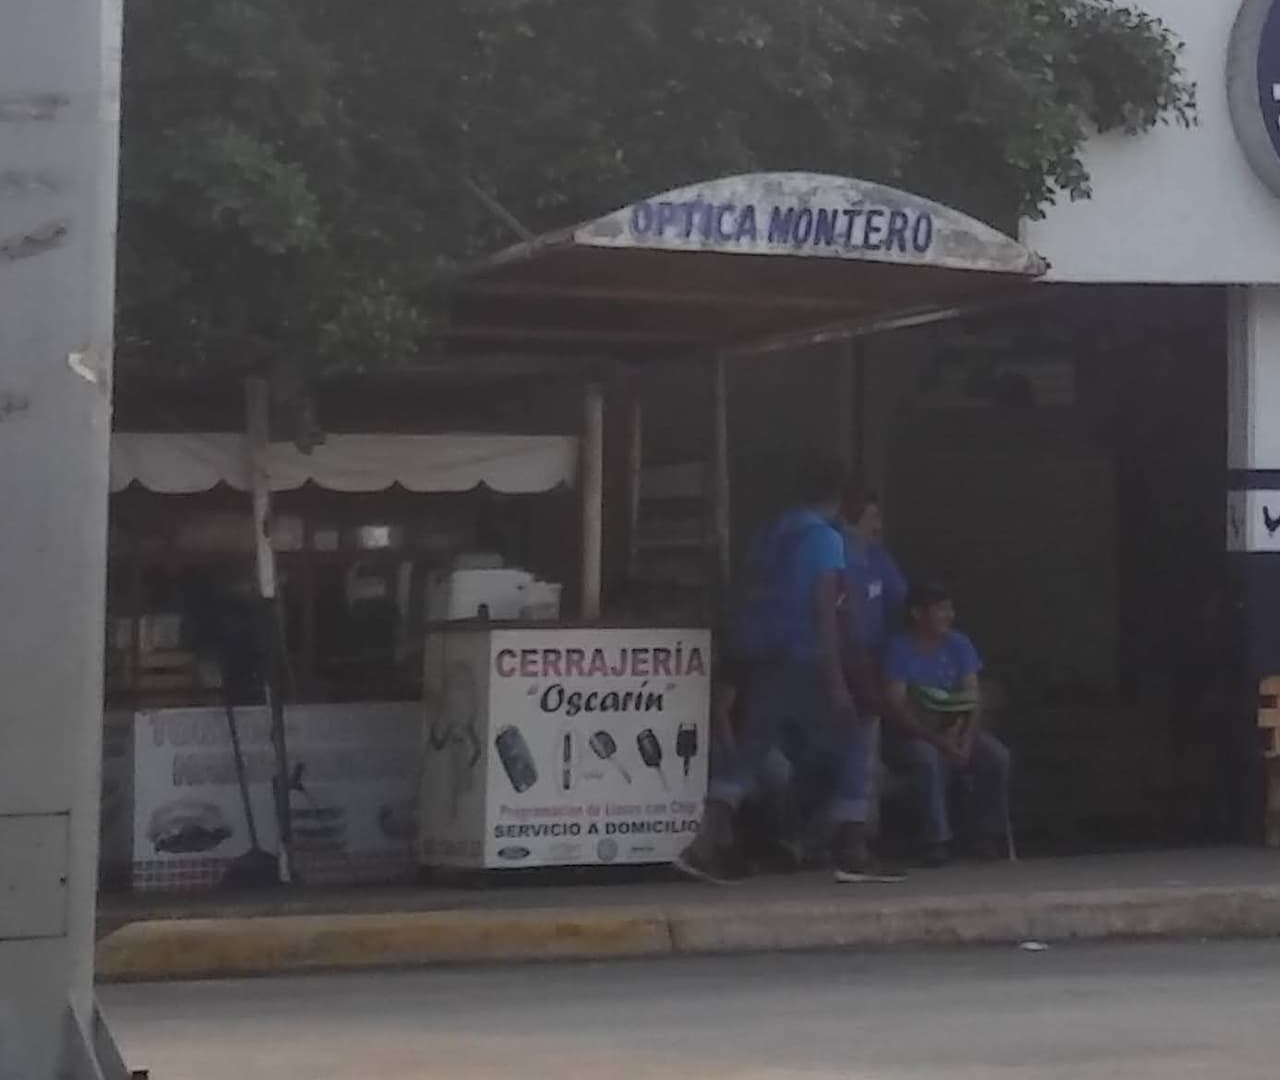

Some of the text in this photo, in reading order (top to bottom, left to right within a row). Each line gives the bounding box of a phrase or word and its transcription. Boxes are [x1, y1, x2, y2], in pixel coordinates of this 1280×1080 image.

[630, 201, 934, 254] OPTICA MONTERO
[495, 640, 708, 678] CERRAJERÍA
[493, 819, 700, 839] SERVICIO A DOMICILIO
